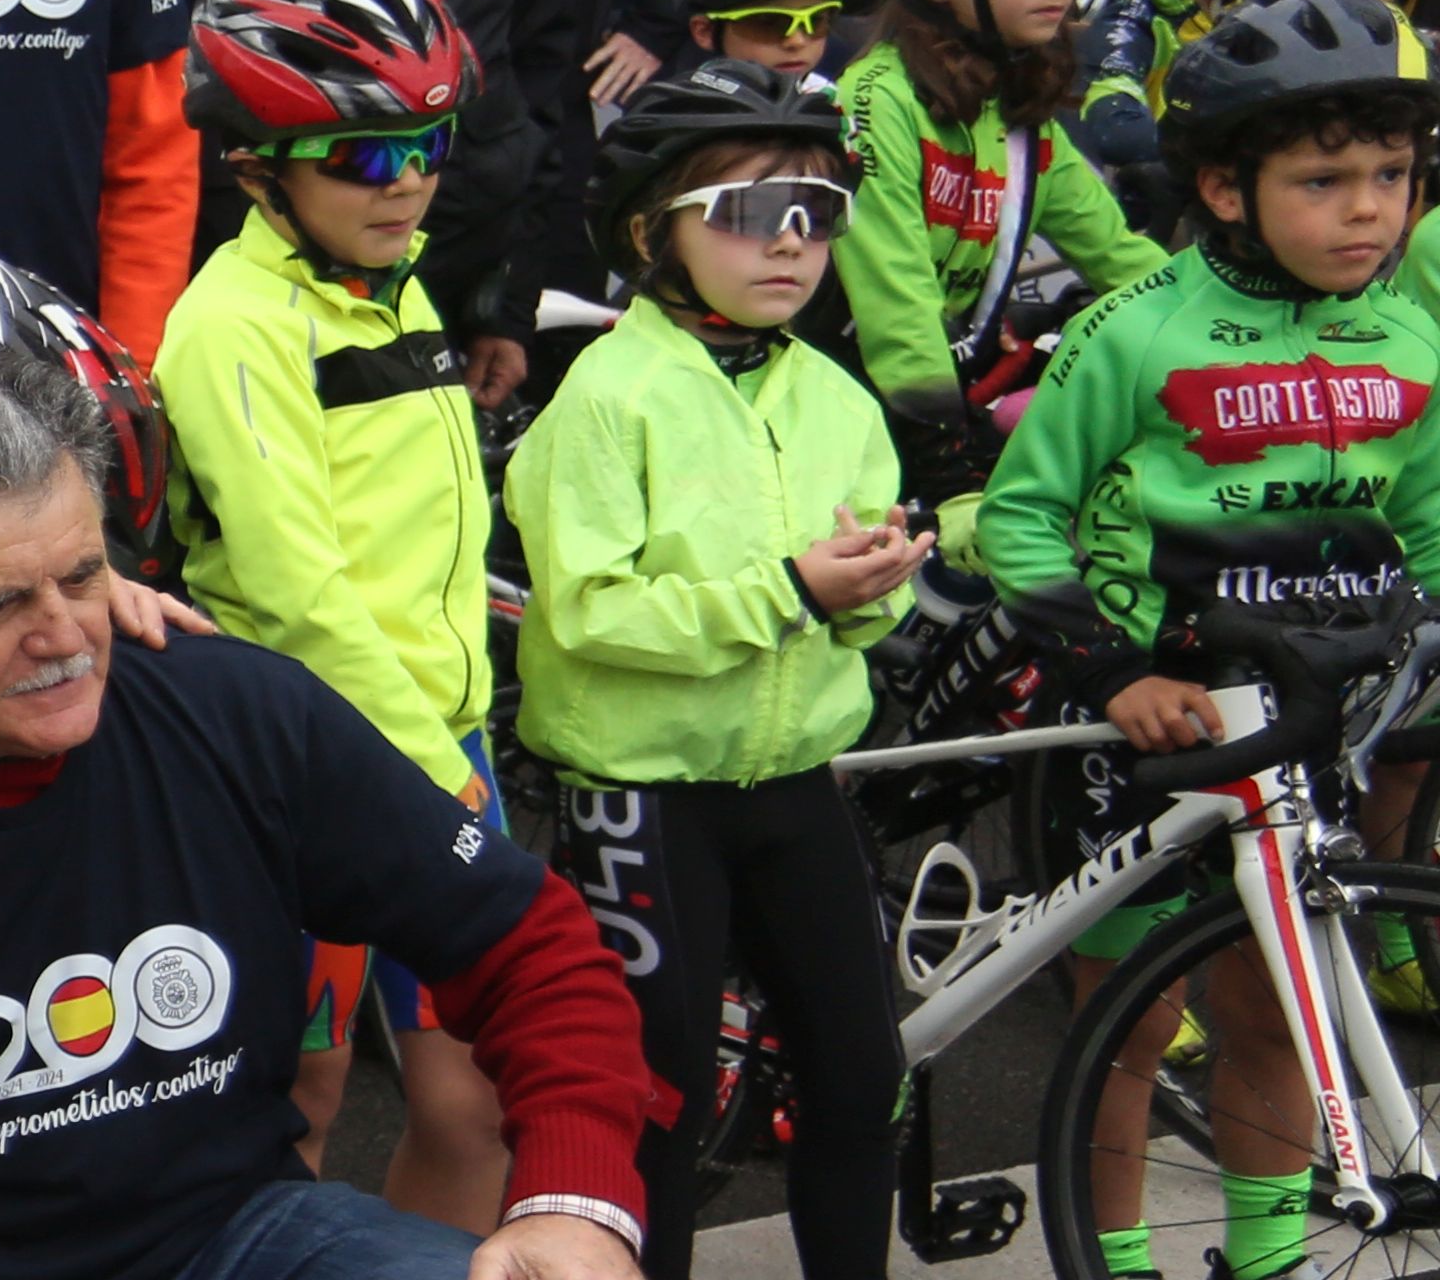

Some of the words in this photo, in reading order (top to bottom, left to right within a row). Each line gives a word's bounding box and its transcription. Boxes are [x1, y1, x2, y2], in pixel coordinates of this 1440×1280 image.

[21, 30, 91, 60] contigo
[1048, 344, 1082, 389] las
[1081, 265, 1178, 340] mestas
[1213, 378, 1324, 430] CORTE
[1326, 376, 1402, 422] ASTUR
[451, 820, 482, 865] 1824
[1001, 825, 1149, 947] GIANT
[35, 1067, 65, 1087] 2024
[151, 1048, 243, 1106] contigo
[1323, 1090, 1361, 1176] GIANT
